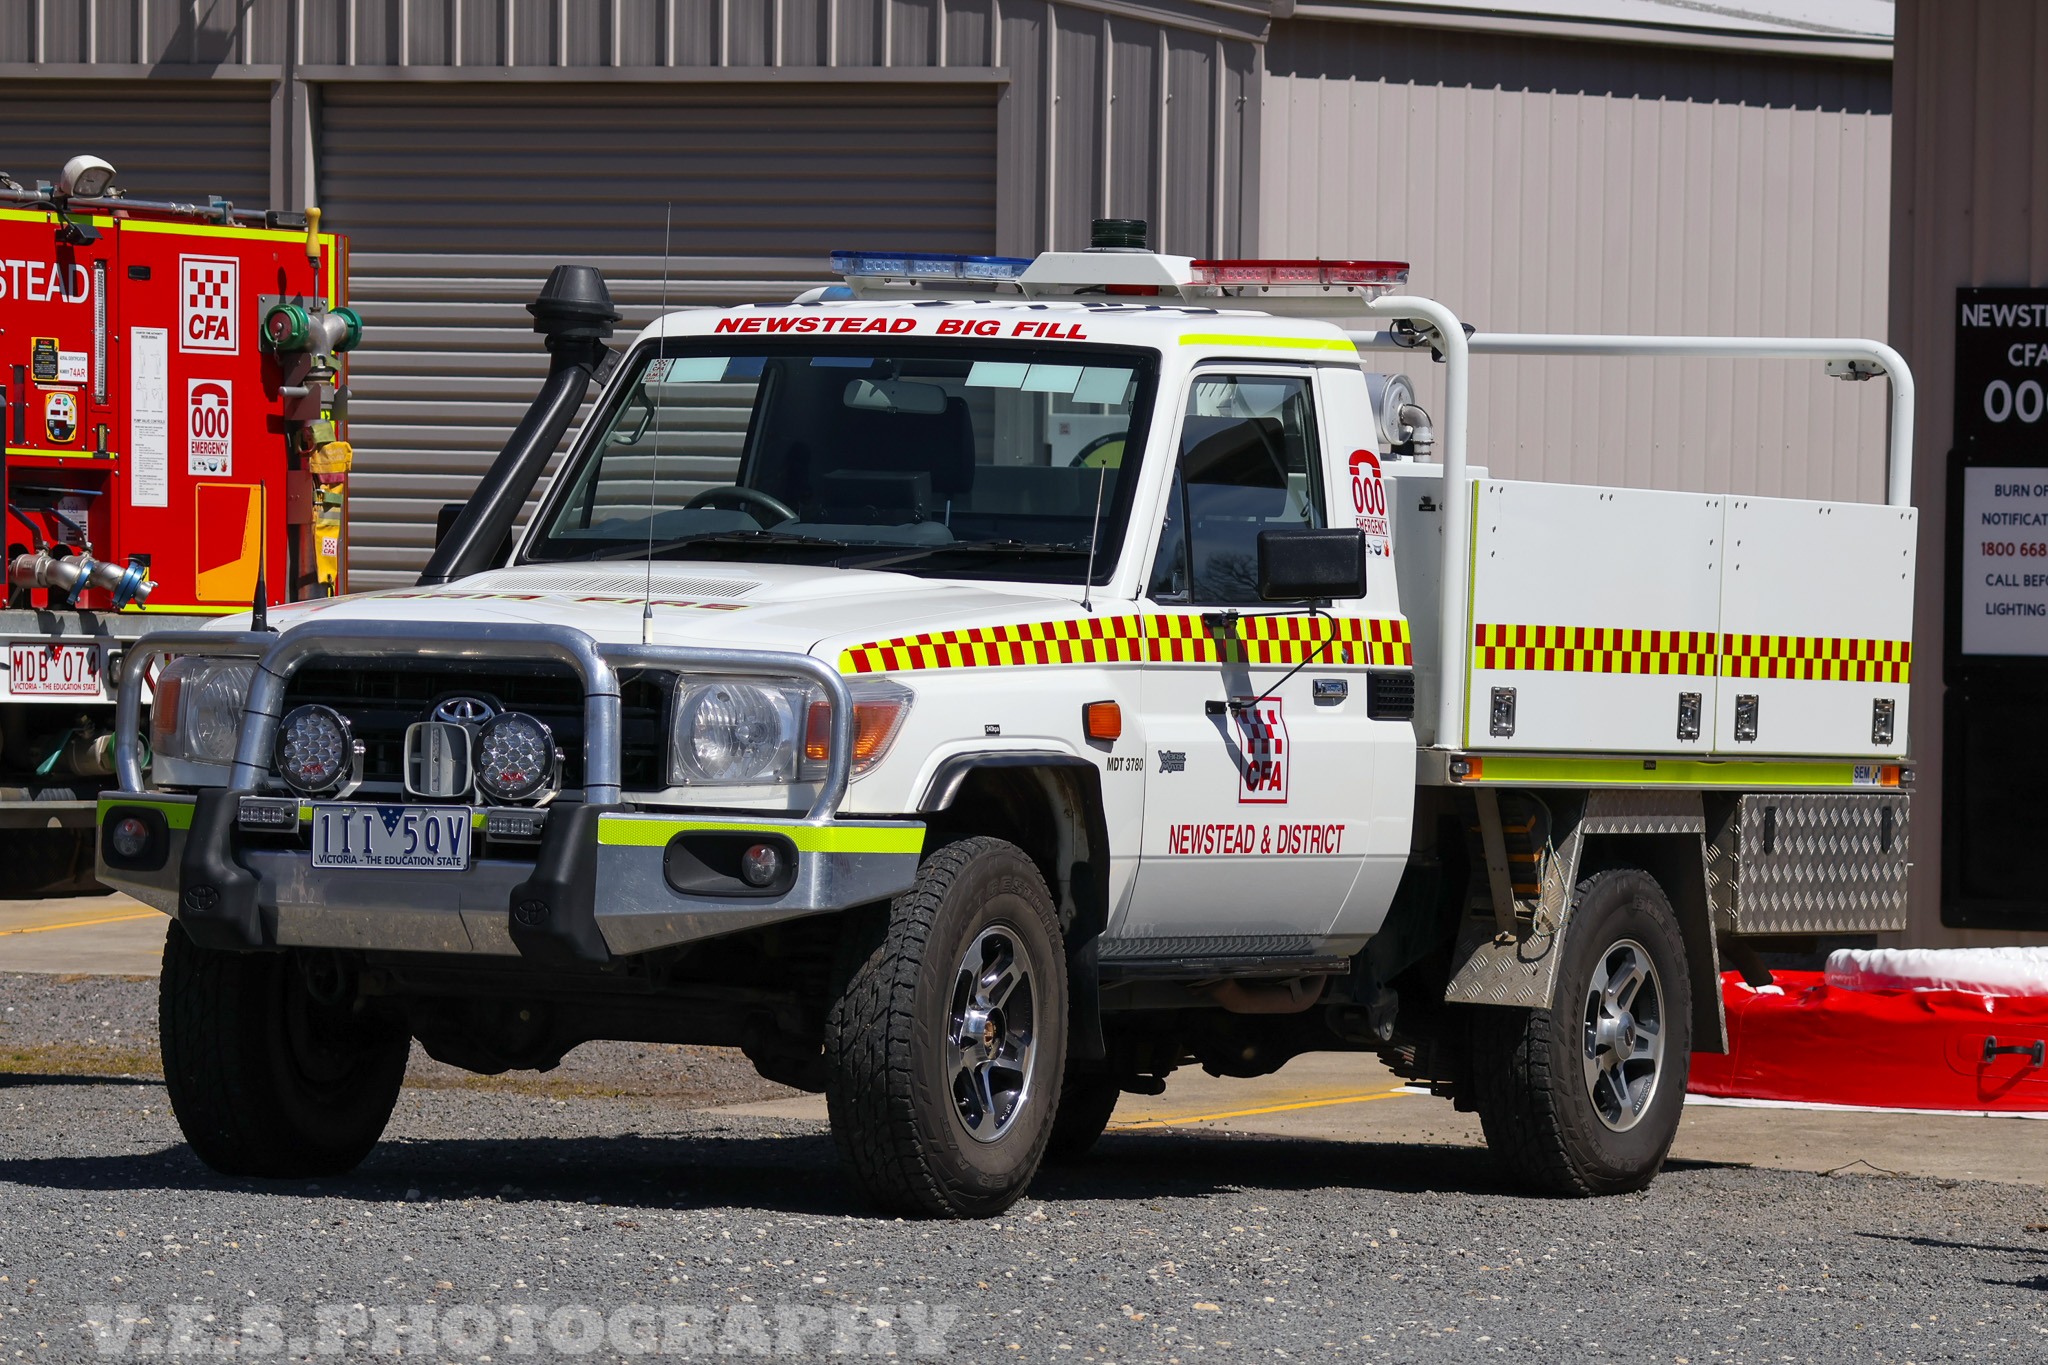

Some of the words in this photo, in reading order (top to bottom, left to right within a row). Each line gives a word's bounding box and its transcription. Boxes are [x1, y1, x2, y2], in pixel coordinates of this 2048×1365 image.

[189, 314, 229, 340] CFA
[1962, 304, 2048, 327] NEWST
[714, 317, 917, 333] NEWSTEAD
[935, 319, 1001, 335] BIG
[1011, 322, 1088, 339] FILL
[2008, 343, 2048, 366] CFA
[1983, 380, 2048, 423] 00
[192, 407, 229, 438] 000
[192, 442, 228, 455] EMERGENCY
[1352, 476, 1385, 516] 000
[1995, 485, 2030, 497] BURN
[1981, 542, 2015, 556] 1800
[2020, 543, 2047, 556] 668
[1986, 574, 2019, 587] CALL
[2024, 575, 2048, 587] BEF
[1986, 603, 2046, 616] LIGHTING
[13, 651, 48, 682] MDB
[63, 652, 96, 682] 074
[1107, 757, 1124, 771] MDT
[1126, 758, 1144, 771] 3780
[1246, 760, 1282, 791] CFA
[1854, 766, 1870, 779] SEM
[404, 815, 465, 856] 5QV
[1169, 824, 1255, 854] NEWSTEAD
[1261, 825, 1271, 854] &
[1277, 824, 1345, 854] DISTRICT
[318, 855, 357, 864] VICTORIA
[366, 856, 382, 865] THE
[385, 856, 434, 866] EDUCATION
[437, 857, 461, 866] STATE
